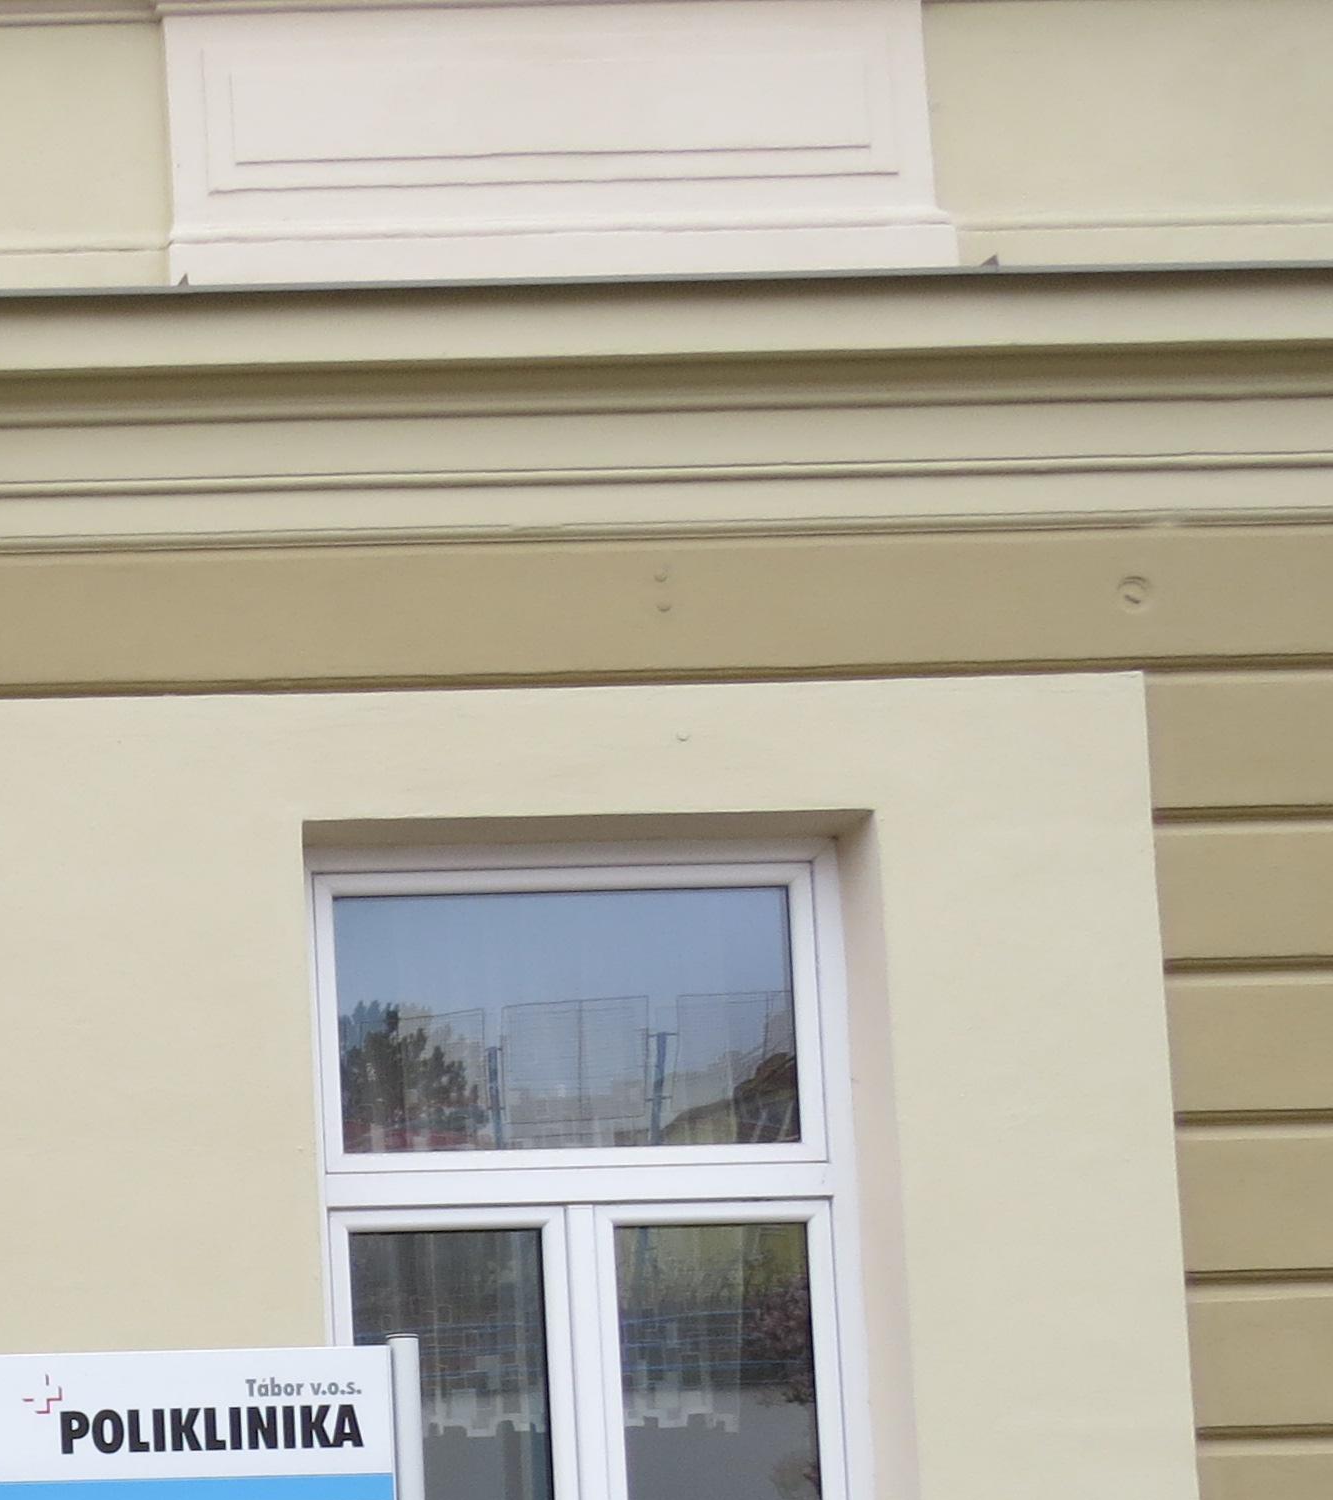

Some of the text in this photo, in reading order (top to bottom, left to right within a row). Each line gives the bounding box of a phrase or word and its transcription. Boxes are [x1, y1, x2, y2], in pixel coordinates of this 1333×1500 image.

[245, 1376, 362, 1398] Tábor v.o.s.
[60, 1405, 364, 1455] POLIKLINIKA
